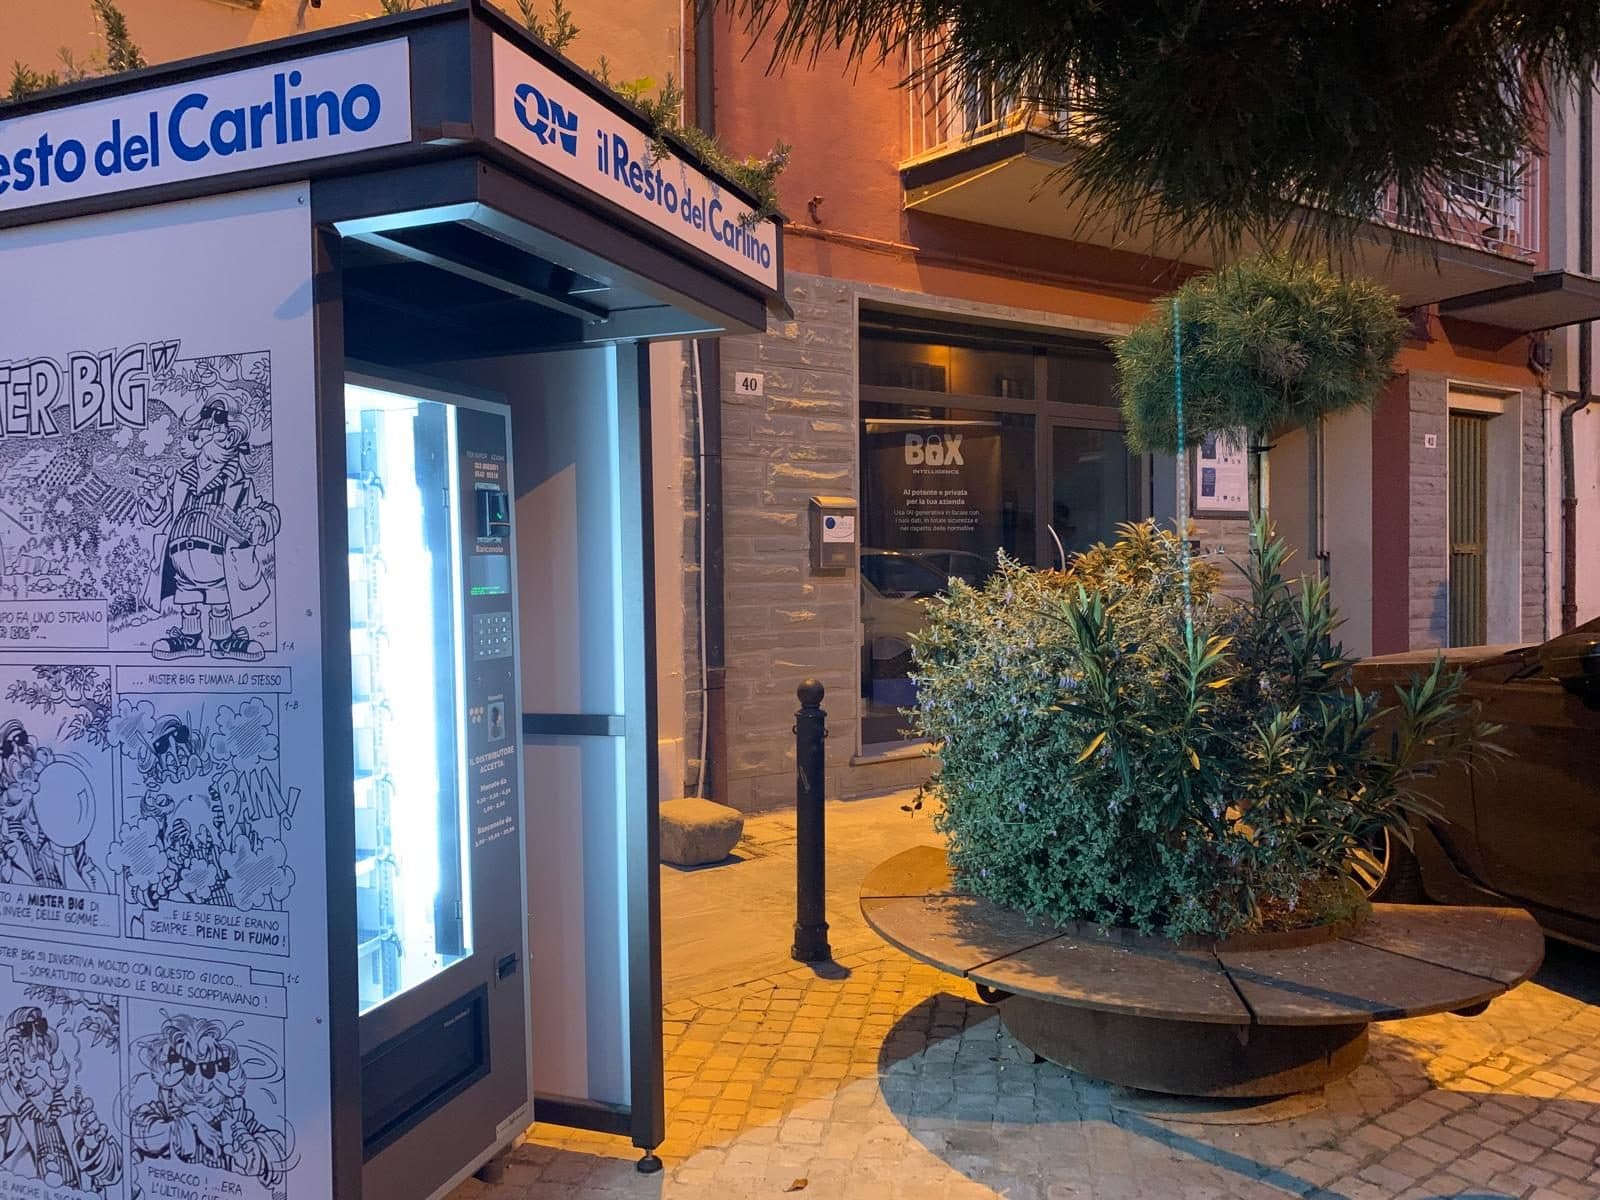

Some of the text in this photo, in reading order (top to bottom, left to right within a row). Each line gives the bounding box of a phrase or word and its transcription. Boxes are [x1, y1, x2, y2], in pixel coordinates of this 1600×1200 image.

[95, 111, 160, 176] del
[168, 70, 381, 162] Carlino
[514, 83, 578, 157] QN
[597, 129, 771, 269] il Resto del Carlino
[742, 377, 757, 391] 40
[944, 489, 968, 497] privata
[33, 611, 55, 623] UNO
[59, 611, 102, 623] STRANO
[148, 674, 176, 685] MISTER
[179, 674, 195, 685] BIG
[199, 674, 235, 685] FUMAVA
[238, 673, 249, 686] LO
[251, 674, 282, 686] STESSO
[17, 893, 24, 904] A
[28, 893, 65, 909] MISTER
[68, 897, 84, 910] BIG
[90, 901, 99, 912] DI
[36, 908, 61, 920] DELLE
[182, 911, 192, 921] LE
[195, 912, 210, 923] SUE
[214, 914, 241, 926] BOLLE
[244, 917, 279, 931] ERANO
[196, 925, 228, 940] PIENE
[234, 930, 244, 942] DI
[21, 949, 35, 960] BIG
[48, 953, 94, 968] DIVERTIVA
[98, 959, 130, 974] MOLTO
[132, 963, 152, 976] CON
[154, 965, 195, 981] QUESTO
[90, 973, 131, 989] QUANDO
[135, 979, 146, 991] LE
[151, 981, 183, 996] BOLLE
[151, 1182, 198, 1200] L'ULTIMO
